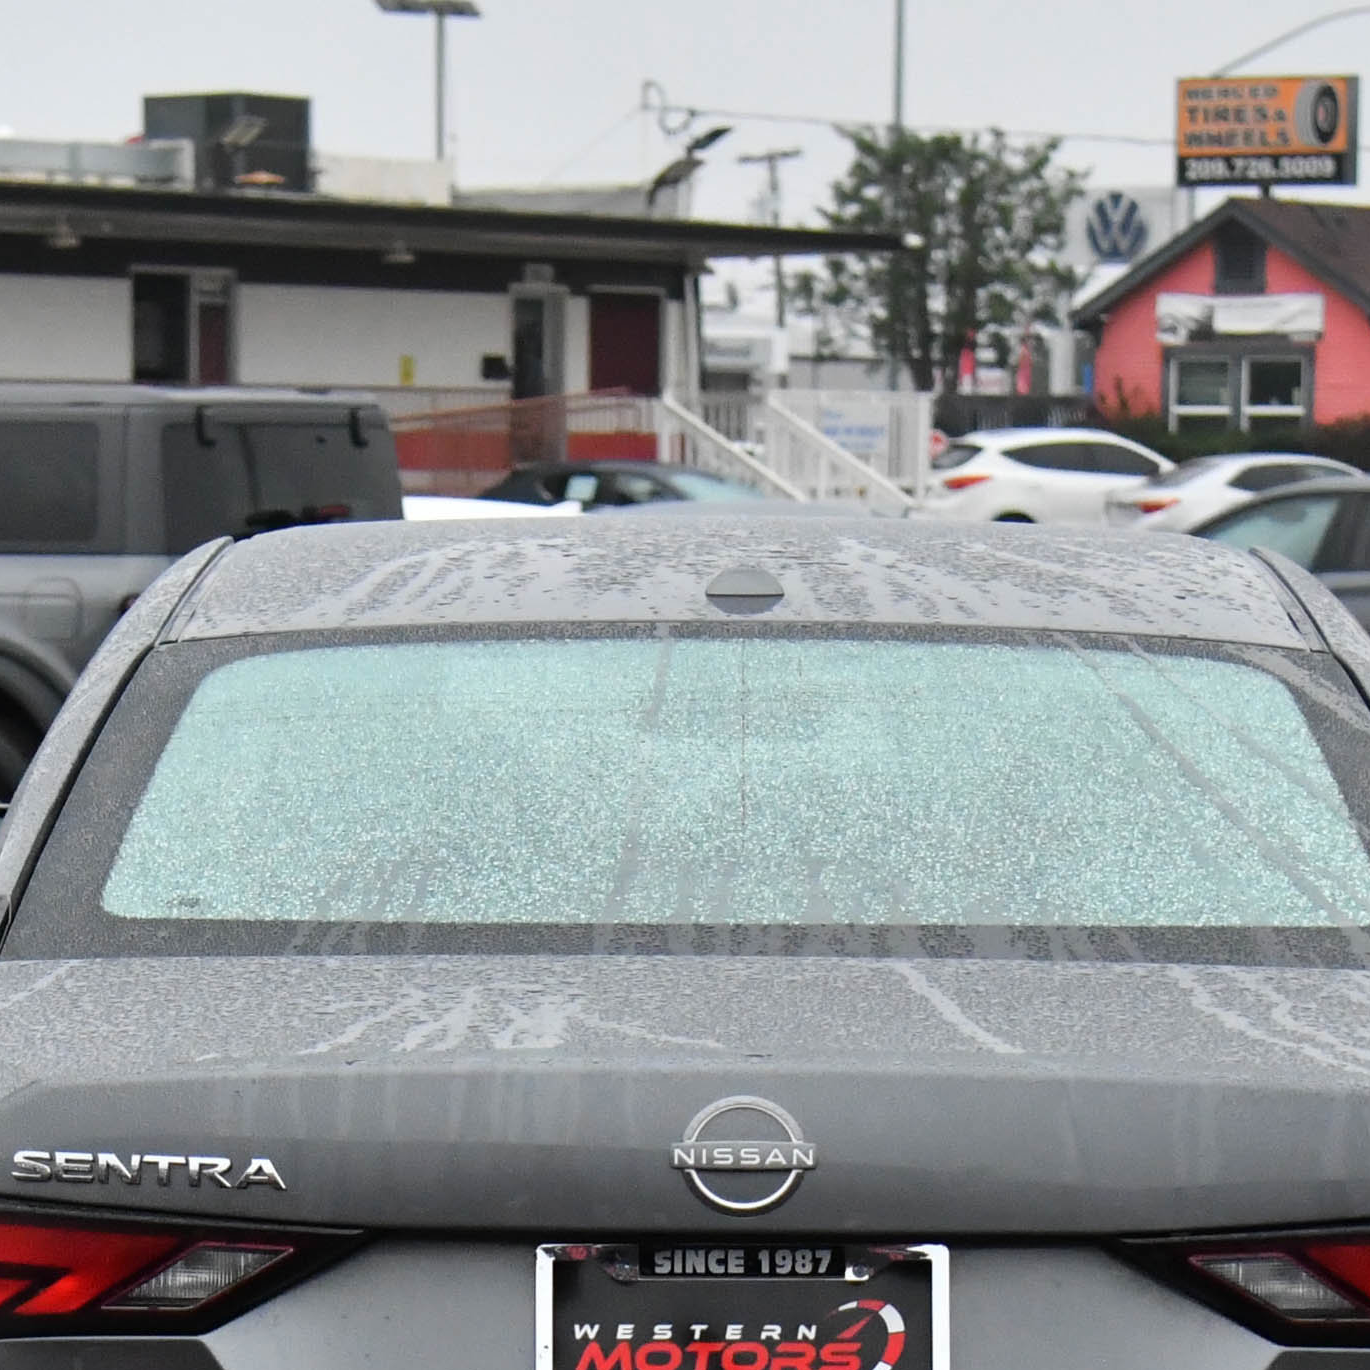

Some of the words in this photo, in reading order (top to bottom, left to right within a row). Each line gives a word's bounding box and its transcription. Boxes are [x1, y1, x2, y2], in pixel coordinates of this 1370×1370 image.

[1186, 106, 1269, 123] TIRES
[1184, 130, 1290, 146] WHEELS
[673, 1148, 814, 1165] NISSAN
[11, 1150, 287, 1190] SENTRA
[654, 1249, 745, 1275] SINCE
[758, 1249, 833, 1275] 1987
[574, 1324, 818, 1340] WESTERN
